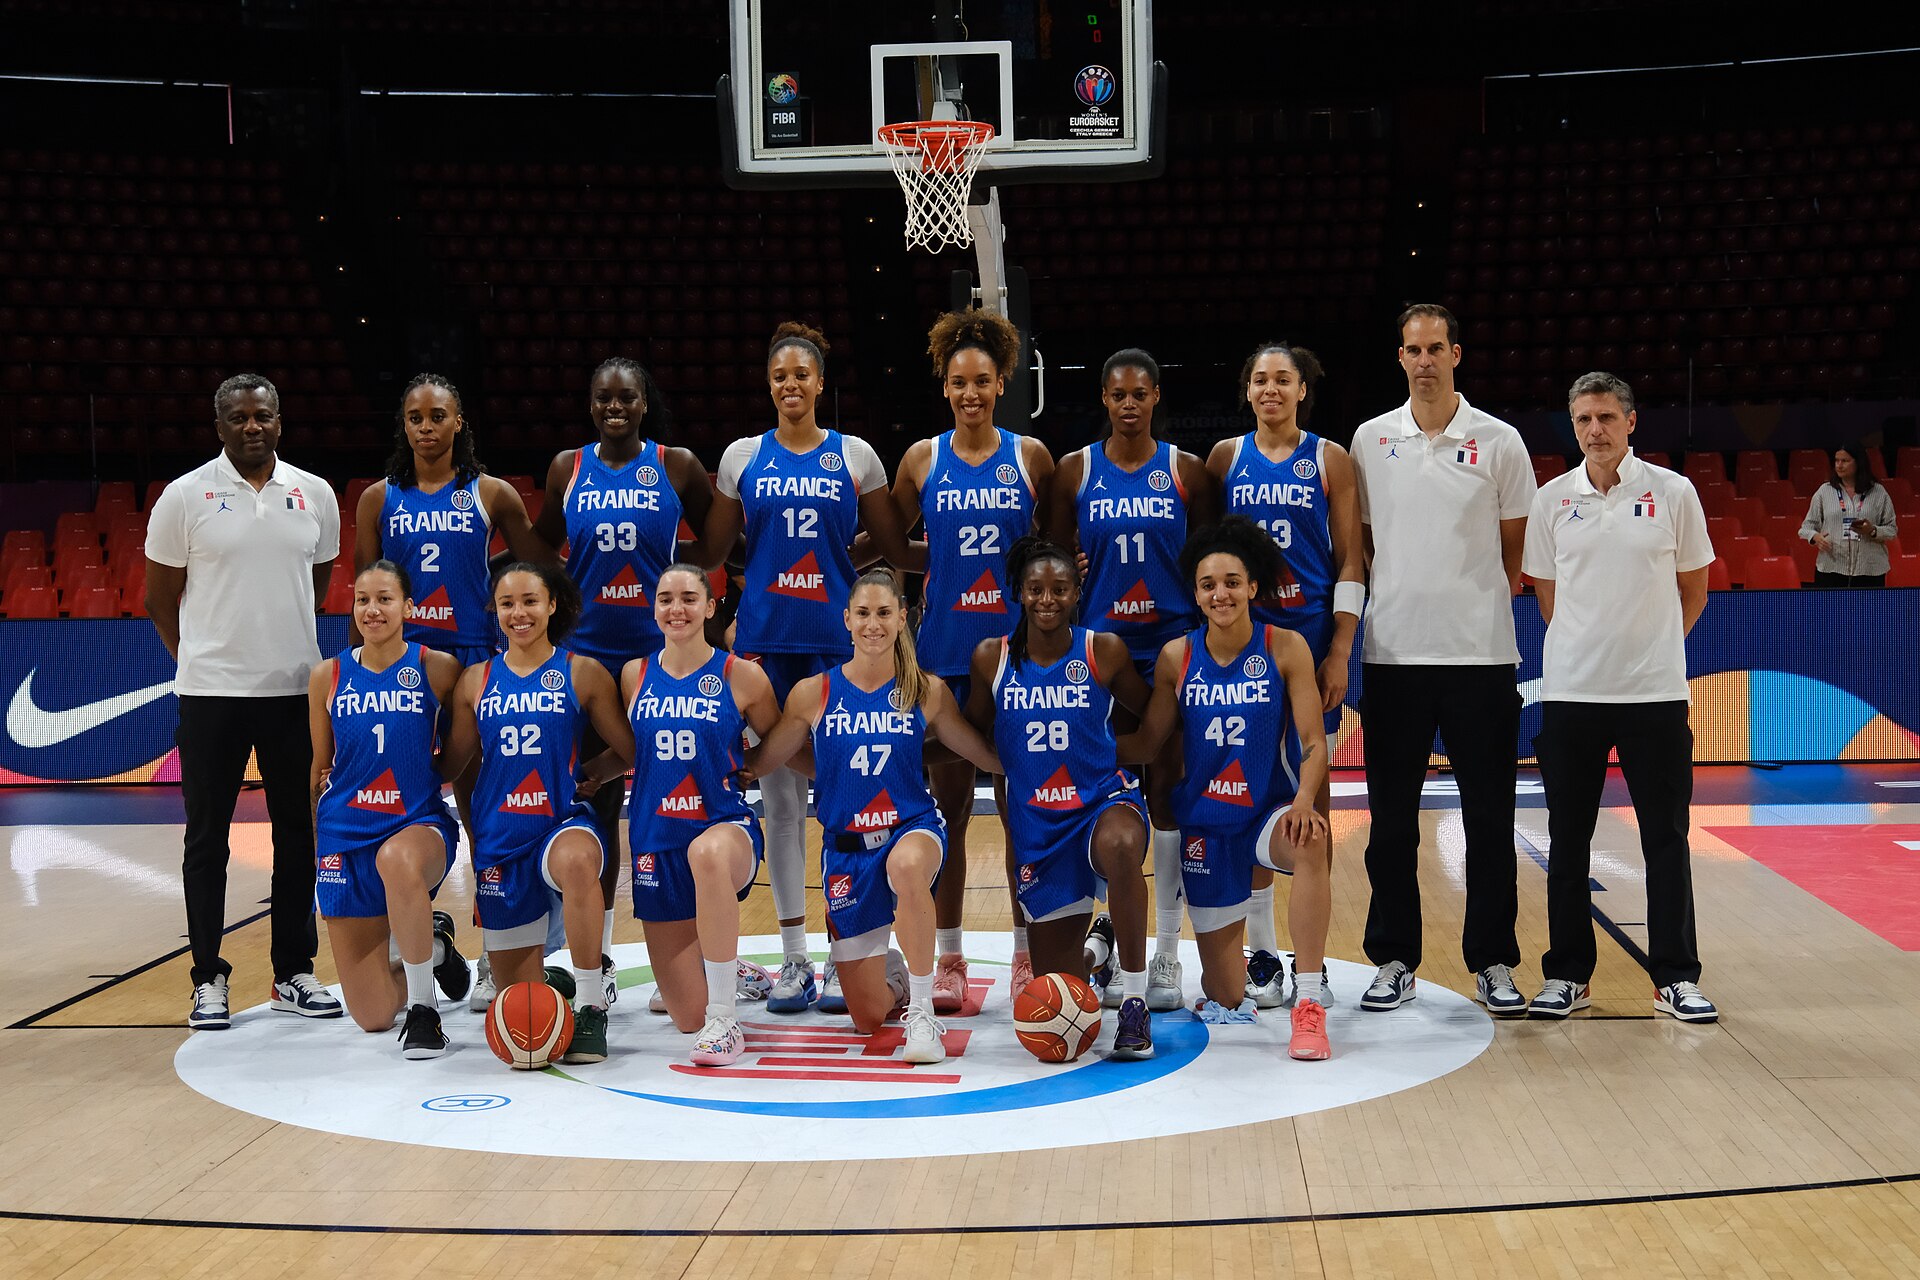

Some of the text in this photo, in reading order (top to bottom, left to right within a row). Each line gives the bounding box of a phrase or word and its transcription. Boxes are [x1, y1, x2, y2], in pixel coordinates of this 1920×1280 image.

[772, 112, 796, 125] FIBA
[1070, 117, 1120, 126] EUROBASKET
[577, 488, 660, 513] FRANCE
[756, 477, 843, 502] FRANCE
[936, 488, 1022, 513] FRANCE
[1233, 484, 1315, 509] FRANCE
[1089, 497, 1175, 521] FRANCE
[389, 510, 474, 538] FRANCE
[782, 508, 818, 538] 12
[595, 522, 637, 552] 33
[958, 524, 1001, 556] 22
[1114, 532, 1145, 564] 11
[420, 543, 440, 572] 2
[601, 583, 643, 600] MAIF
[778, 572, 825, 589] MAIF
[1271, 584, 1301, 600] AIF
[961, 589, 1002, 607] MAIF
[1113, 600, 1155, 616] MAIF
[411, 606, 454, 620] MAIF
[337, 690, 424, 718] FRANCE
[480, 691, 566, 719] FRANCE
[1003, 685, 1090, 710] FRANCE
[1186, 679, 1271, 706] FRANCE
[637, 696, 721, 723] FRANCE
[826, 711, 915, 737] FRANCE
[1026, 720, 1069, 752] 28
[1205, 716, 1246, 747] 42
[371, 724, 385, 754] 1
[500, 724, 542, 756] 32
[655, 729, 697, 761] 98
[849, 744, 892, 776] 47
[357, 790, 401, 805] MAIF
[506, 791, 548, 808] MAIF
[1034, 785, 1077, 803] MAIF
[1208, 779, 1248, 797] MAIF
[661, 795, 703, 812] MAIF
[853, 810, 898, 828] MAIF
[318, 876, 347, 884] 'EPARGNE
[1183, 866, 1211, 875] EPARGNE
